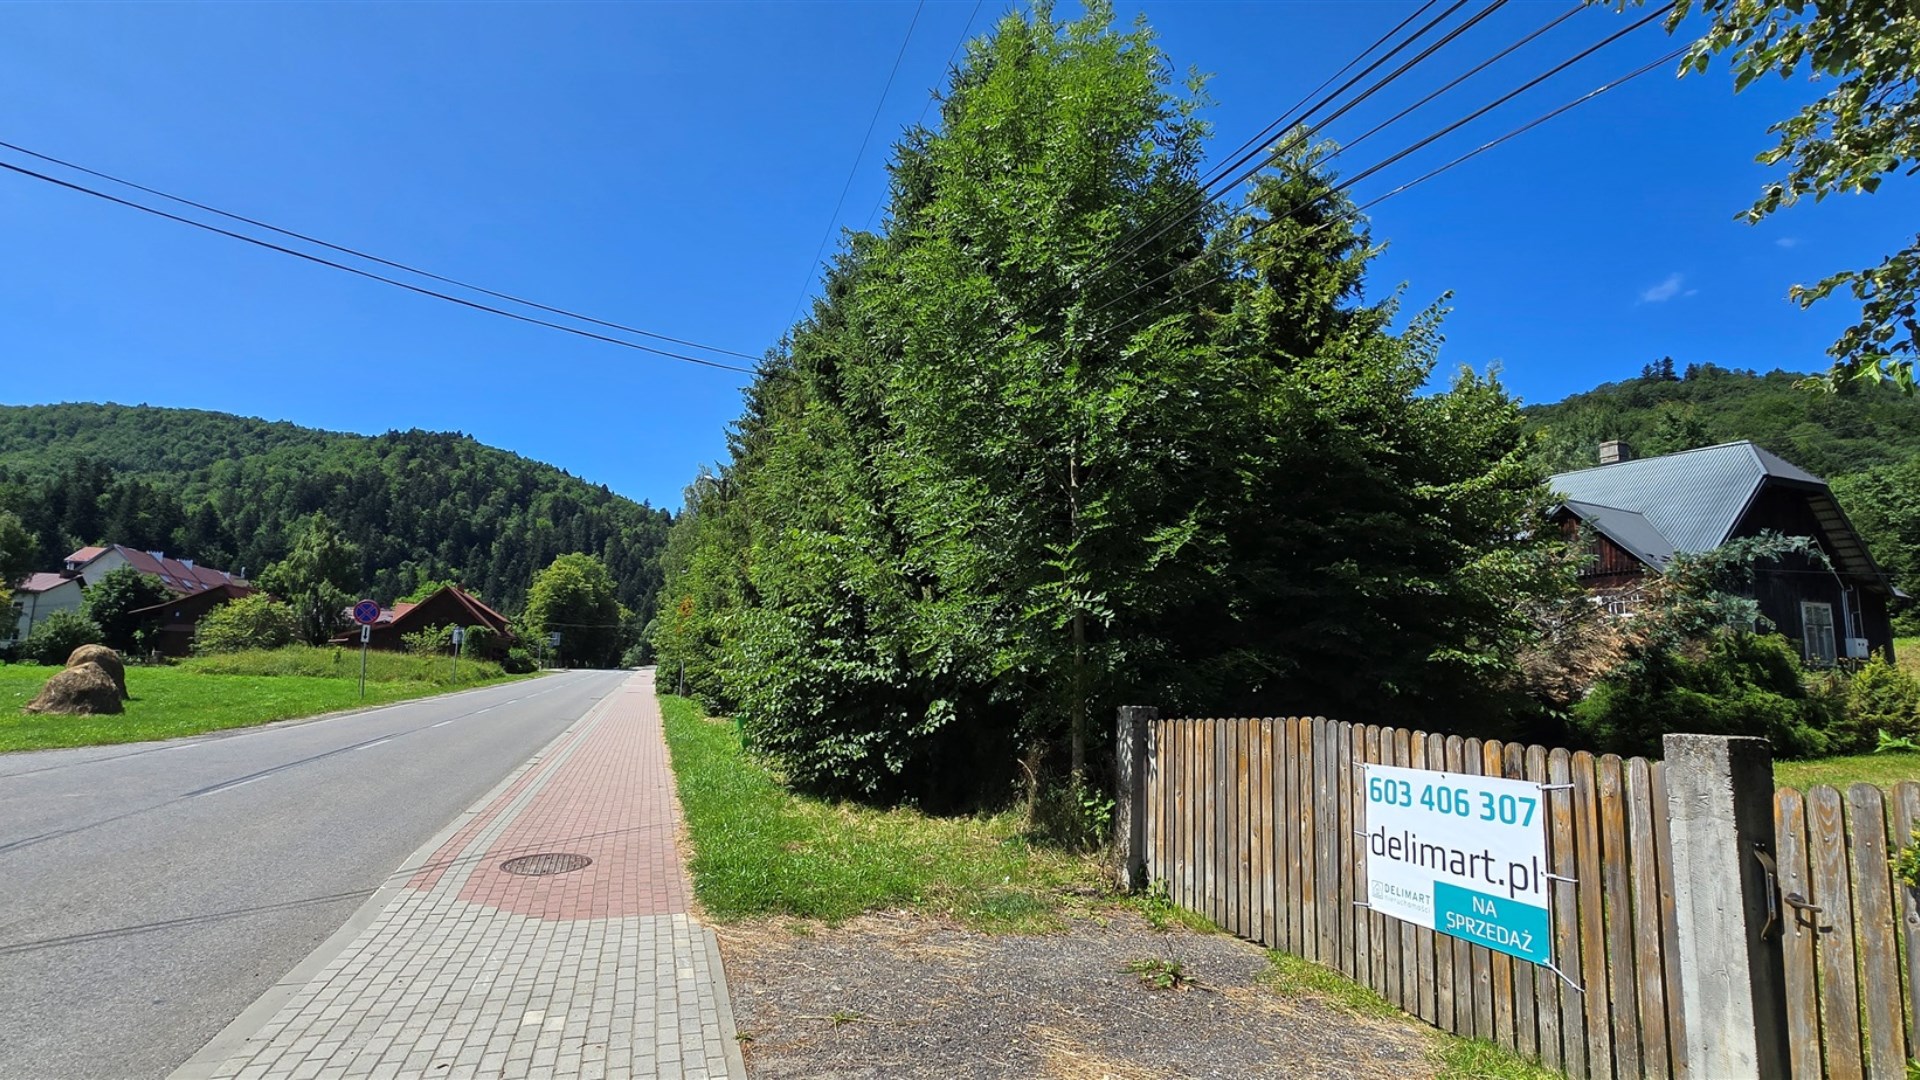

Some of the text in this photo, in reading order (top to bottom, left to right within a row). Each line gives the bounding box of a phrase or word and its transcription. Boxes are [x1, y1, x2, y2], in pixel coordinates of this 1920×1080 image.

[1369, 777, 1536, 827] 603 406 307
[1371, 826, 1539, 898] delimart.pl
[1384, 883, 1431, 905] DELIMART
[1472, 896, 1498, 918] NA
[1446, 911, 1533, 953] SPRZEDAŻ
